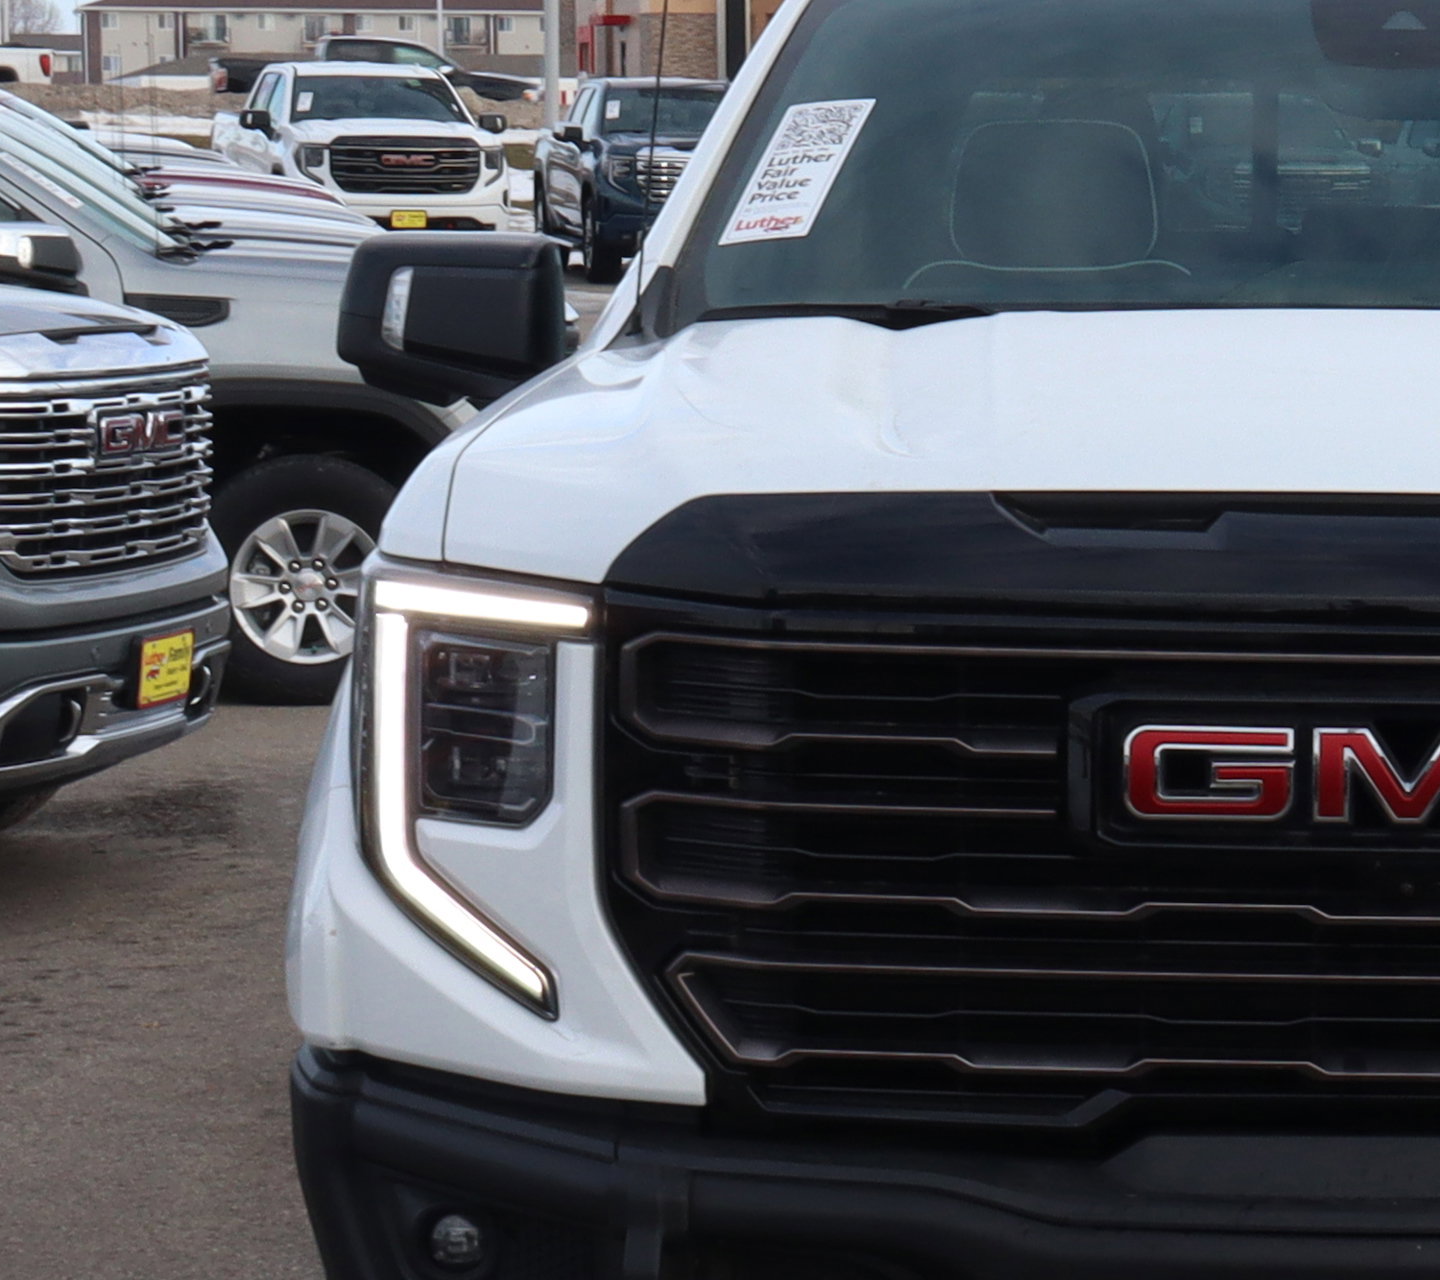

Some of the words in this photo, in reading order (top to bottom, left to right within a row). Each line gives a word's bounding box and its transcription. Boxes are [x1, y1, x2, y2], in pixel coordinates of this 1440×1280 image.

[767, 152, 836, 168] Luther
[761, 168, 798, 181] Fair
[756, 178, 812, 192] Value
[748, 191, 800, 205] Price
[735, 216, 804, 231] Luther
[100, 410, 185, 455] GMC
